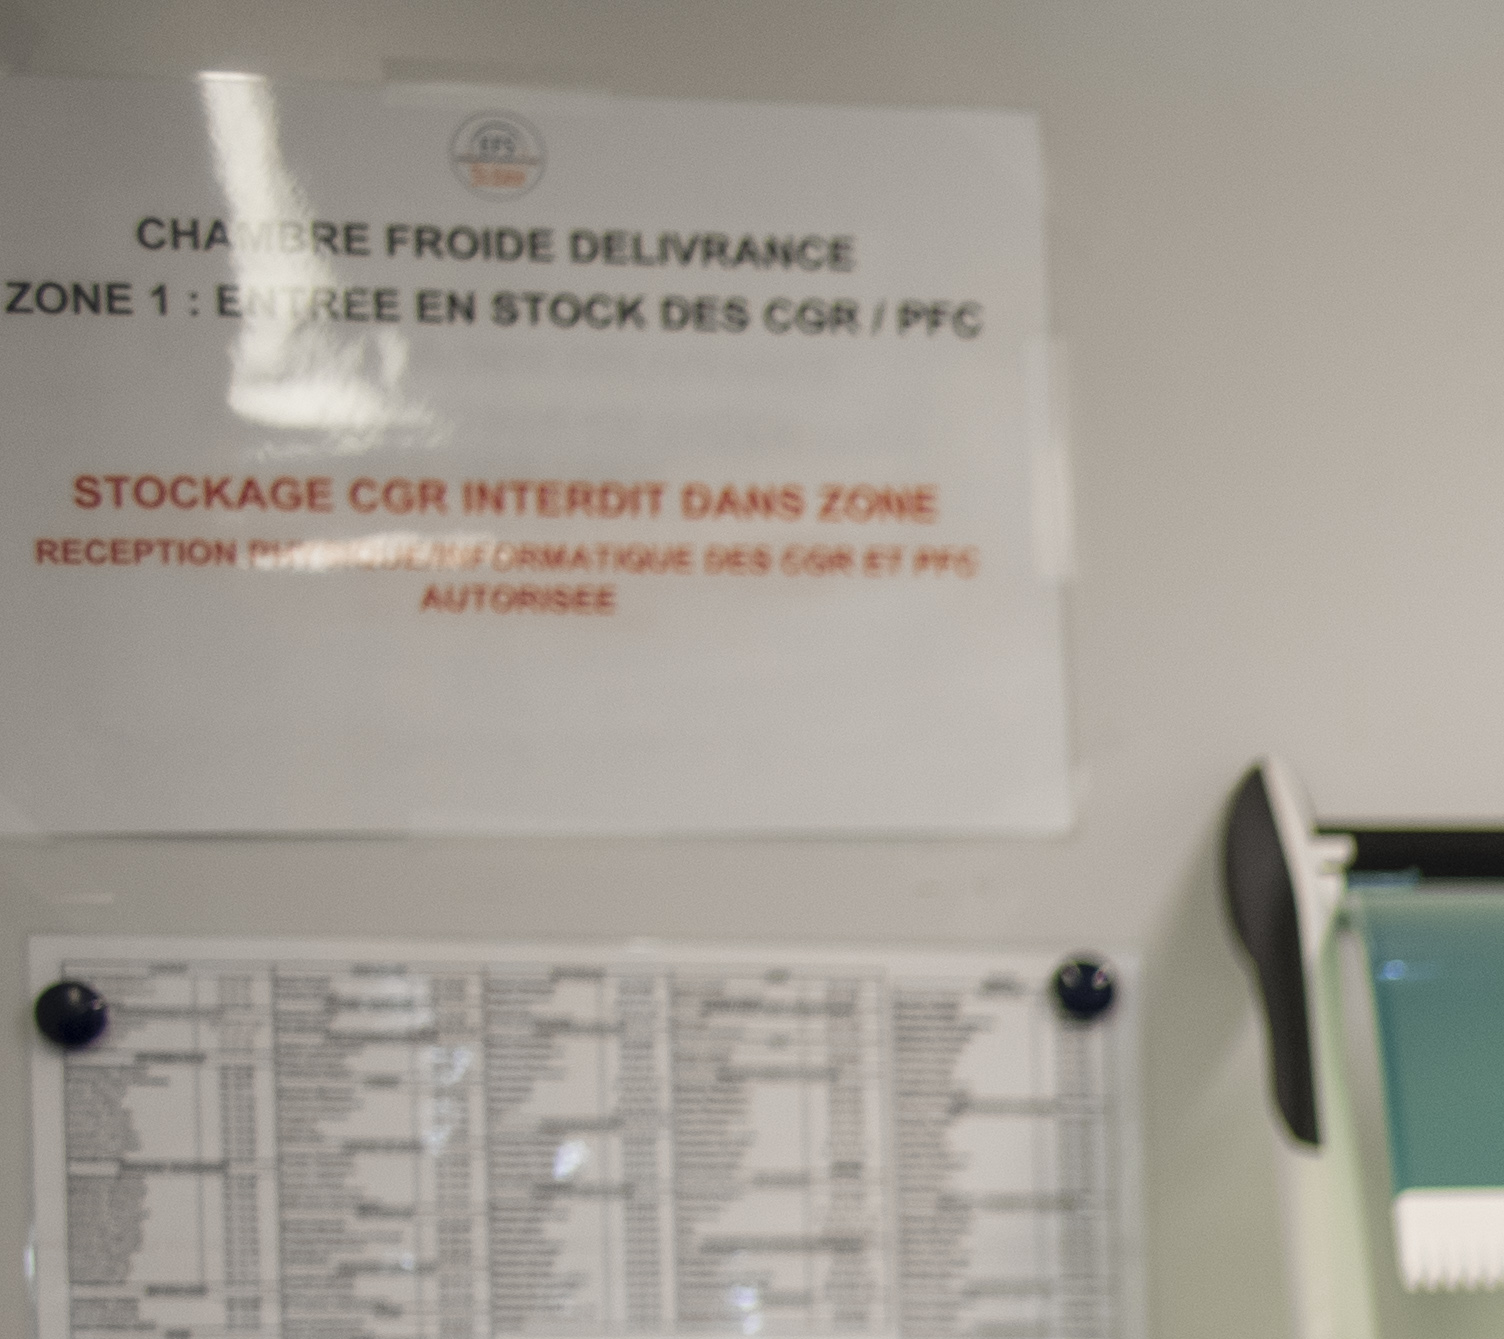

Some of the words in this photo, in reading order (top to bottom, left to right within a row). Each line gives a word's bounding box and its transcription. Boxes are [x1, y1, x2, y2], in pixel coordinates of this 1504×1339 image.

[136, 217, 371, 258] CHAMBRE
[386, 224, 556, 265] FROIDE
[569, 229, 858, 273] DELIVRANCE
[6, 281, 133, 316] ZONE
[150, 283, 168, 316] 1
[216, 283, 401, 324] ENTREE
[416, 288, 477, 325] EN
[491, 290, 648, 330] STOCK
[660, 294, 750, 334] DES
[762, 297, 858, 336] CGR
[870, 299, 887, 336] /
[897, 299, 984, 340] PFC
[73, 474, 334, 512] STOCKAGE
[348, 477, 448, 515] CGR
[462, 478, 664, 520] INTERDIT
[681, 480, 806, 522] DANS
[818, 482, 939, 524] ZONE
[34, 537, 238, 567] RECEPTION
[703, 543, 771, 576] DES
[780, 544, 856, 577] CGR
[861, 544, 903, 578] ET
[911, 544, 980, 580] PFC
[420, 582, 618, 617] AUTORISEE
